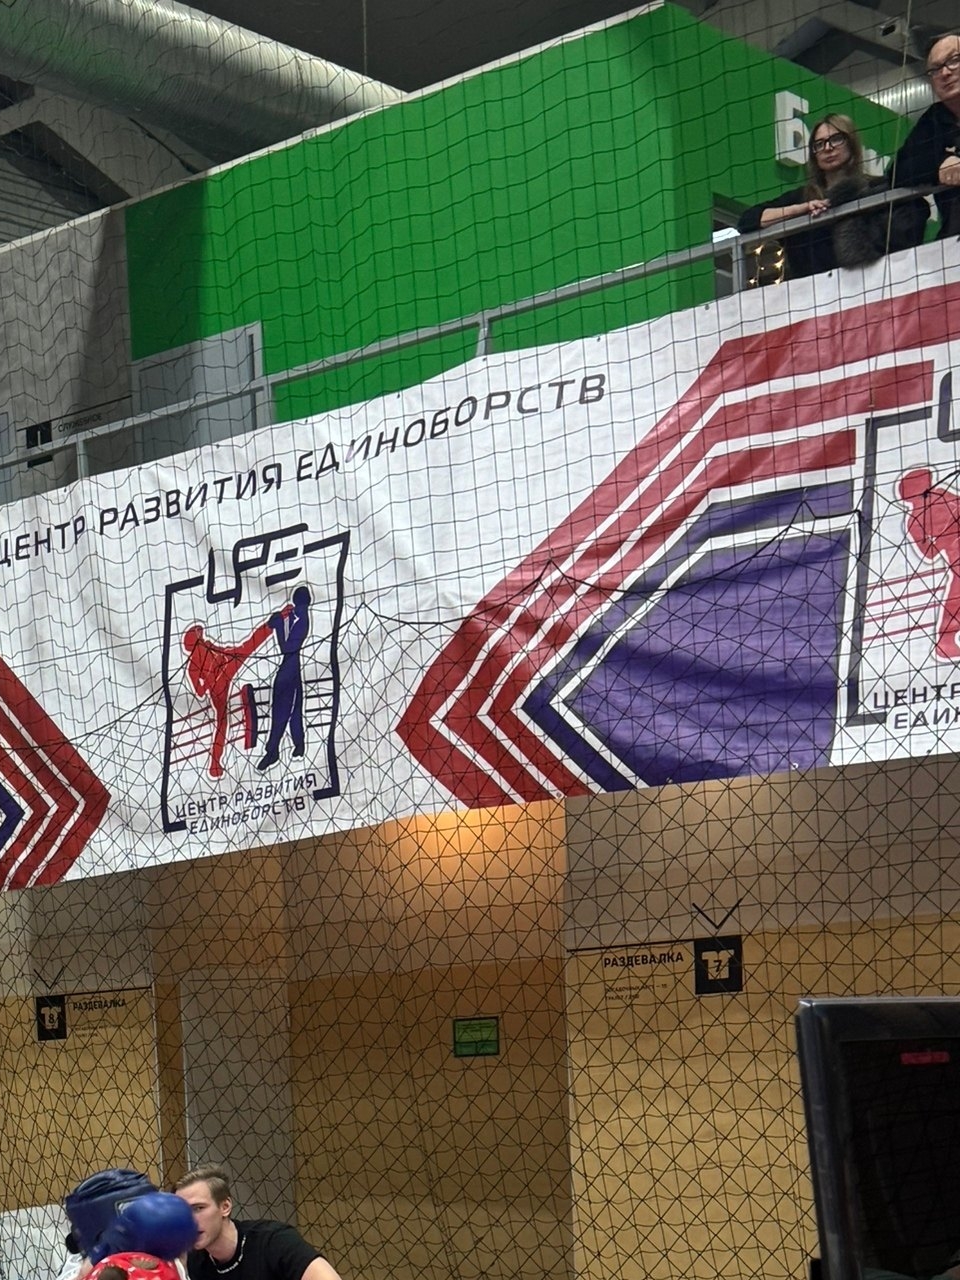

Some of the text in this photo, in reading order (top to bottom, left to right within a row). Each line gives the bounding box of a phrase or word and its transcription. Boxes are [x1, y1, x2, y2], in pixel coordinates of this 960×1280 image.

[98, 462, 285, 537] РАЗВИТИЯ
[295, 373, 607, 482] ЕДИНОБОРСТВ
[176, 772, 318, 818] ЦЕНТР РАЗВИТИЯ
[190, 796, 306, 835] ЕДИНОБОРСТВ
[604, 952, 684, 968] РАЗДЕВАЛКА
[73, 999, 126, 1011] РАЗДЕВАЛКА
